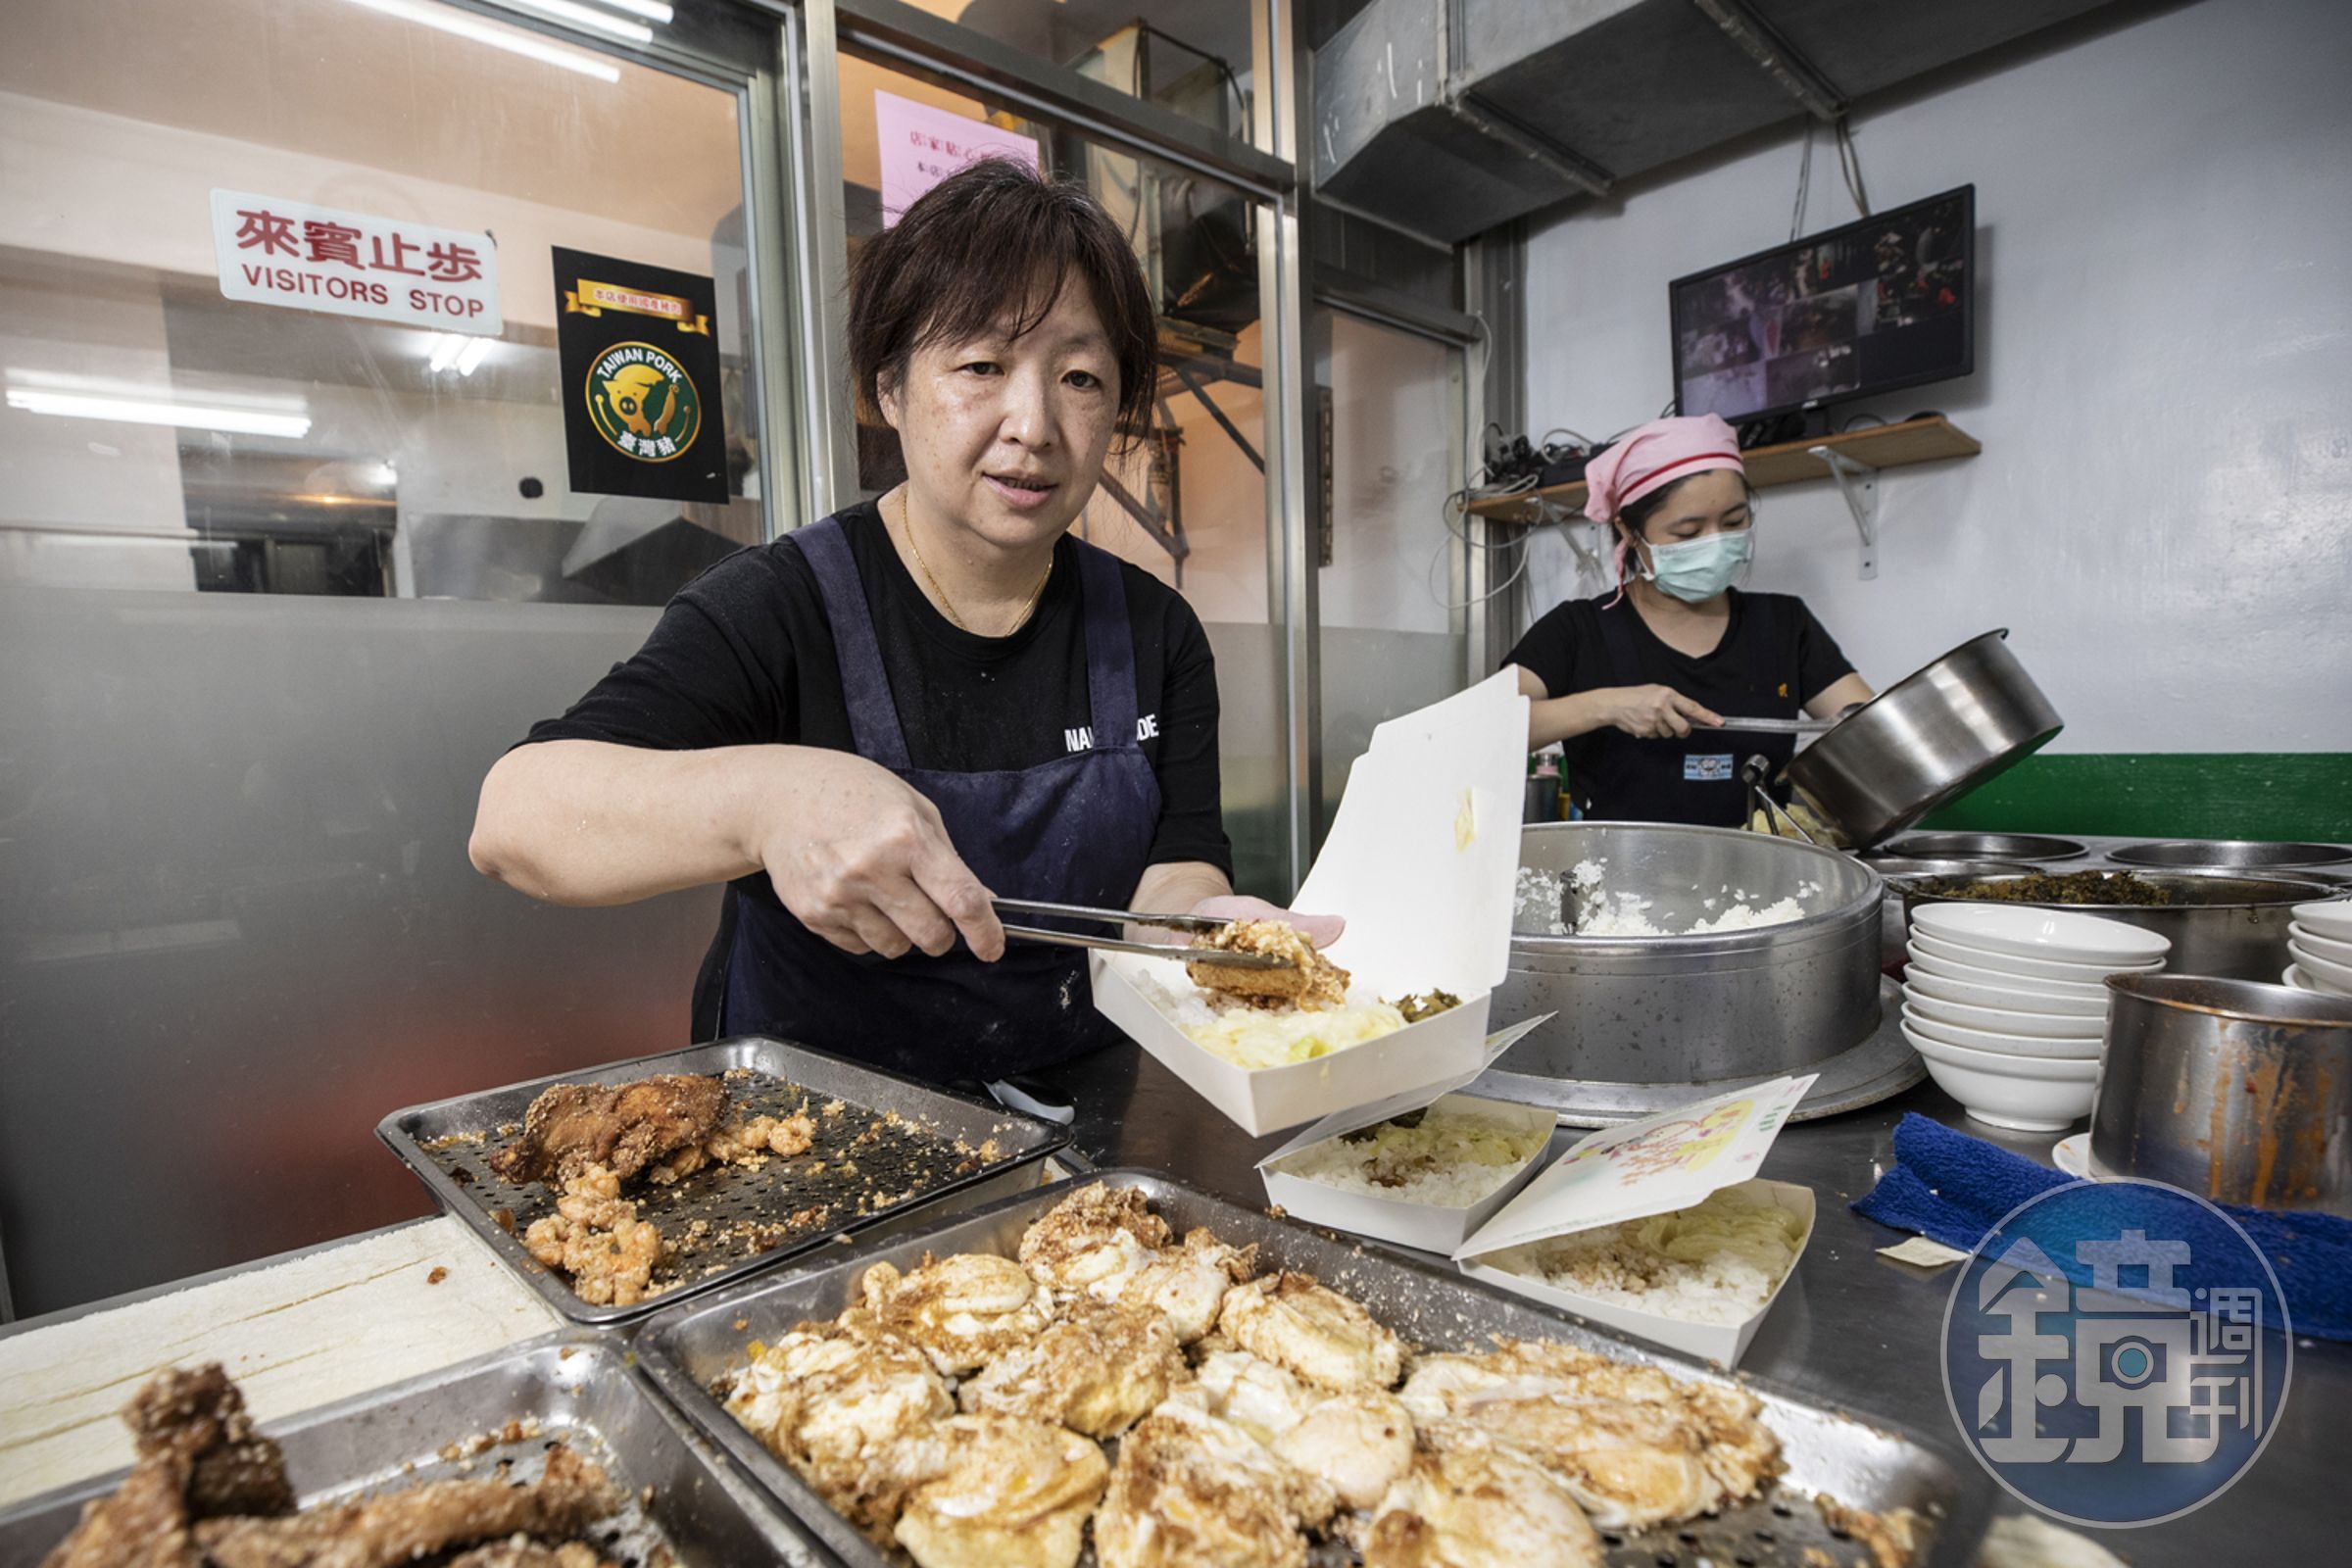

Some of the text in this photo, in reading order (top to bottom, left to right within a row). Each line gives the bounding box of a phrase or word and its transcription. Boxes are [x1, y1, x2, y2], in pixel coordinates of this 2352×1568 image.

[241, 264, 484, 318] VISITORS STOP
[596, 348, 683, 383] TAIWAN PORK
